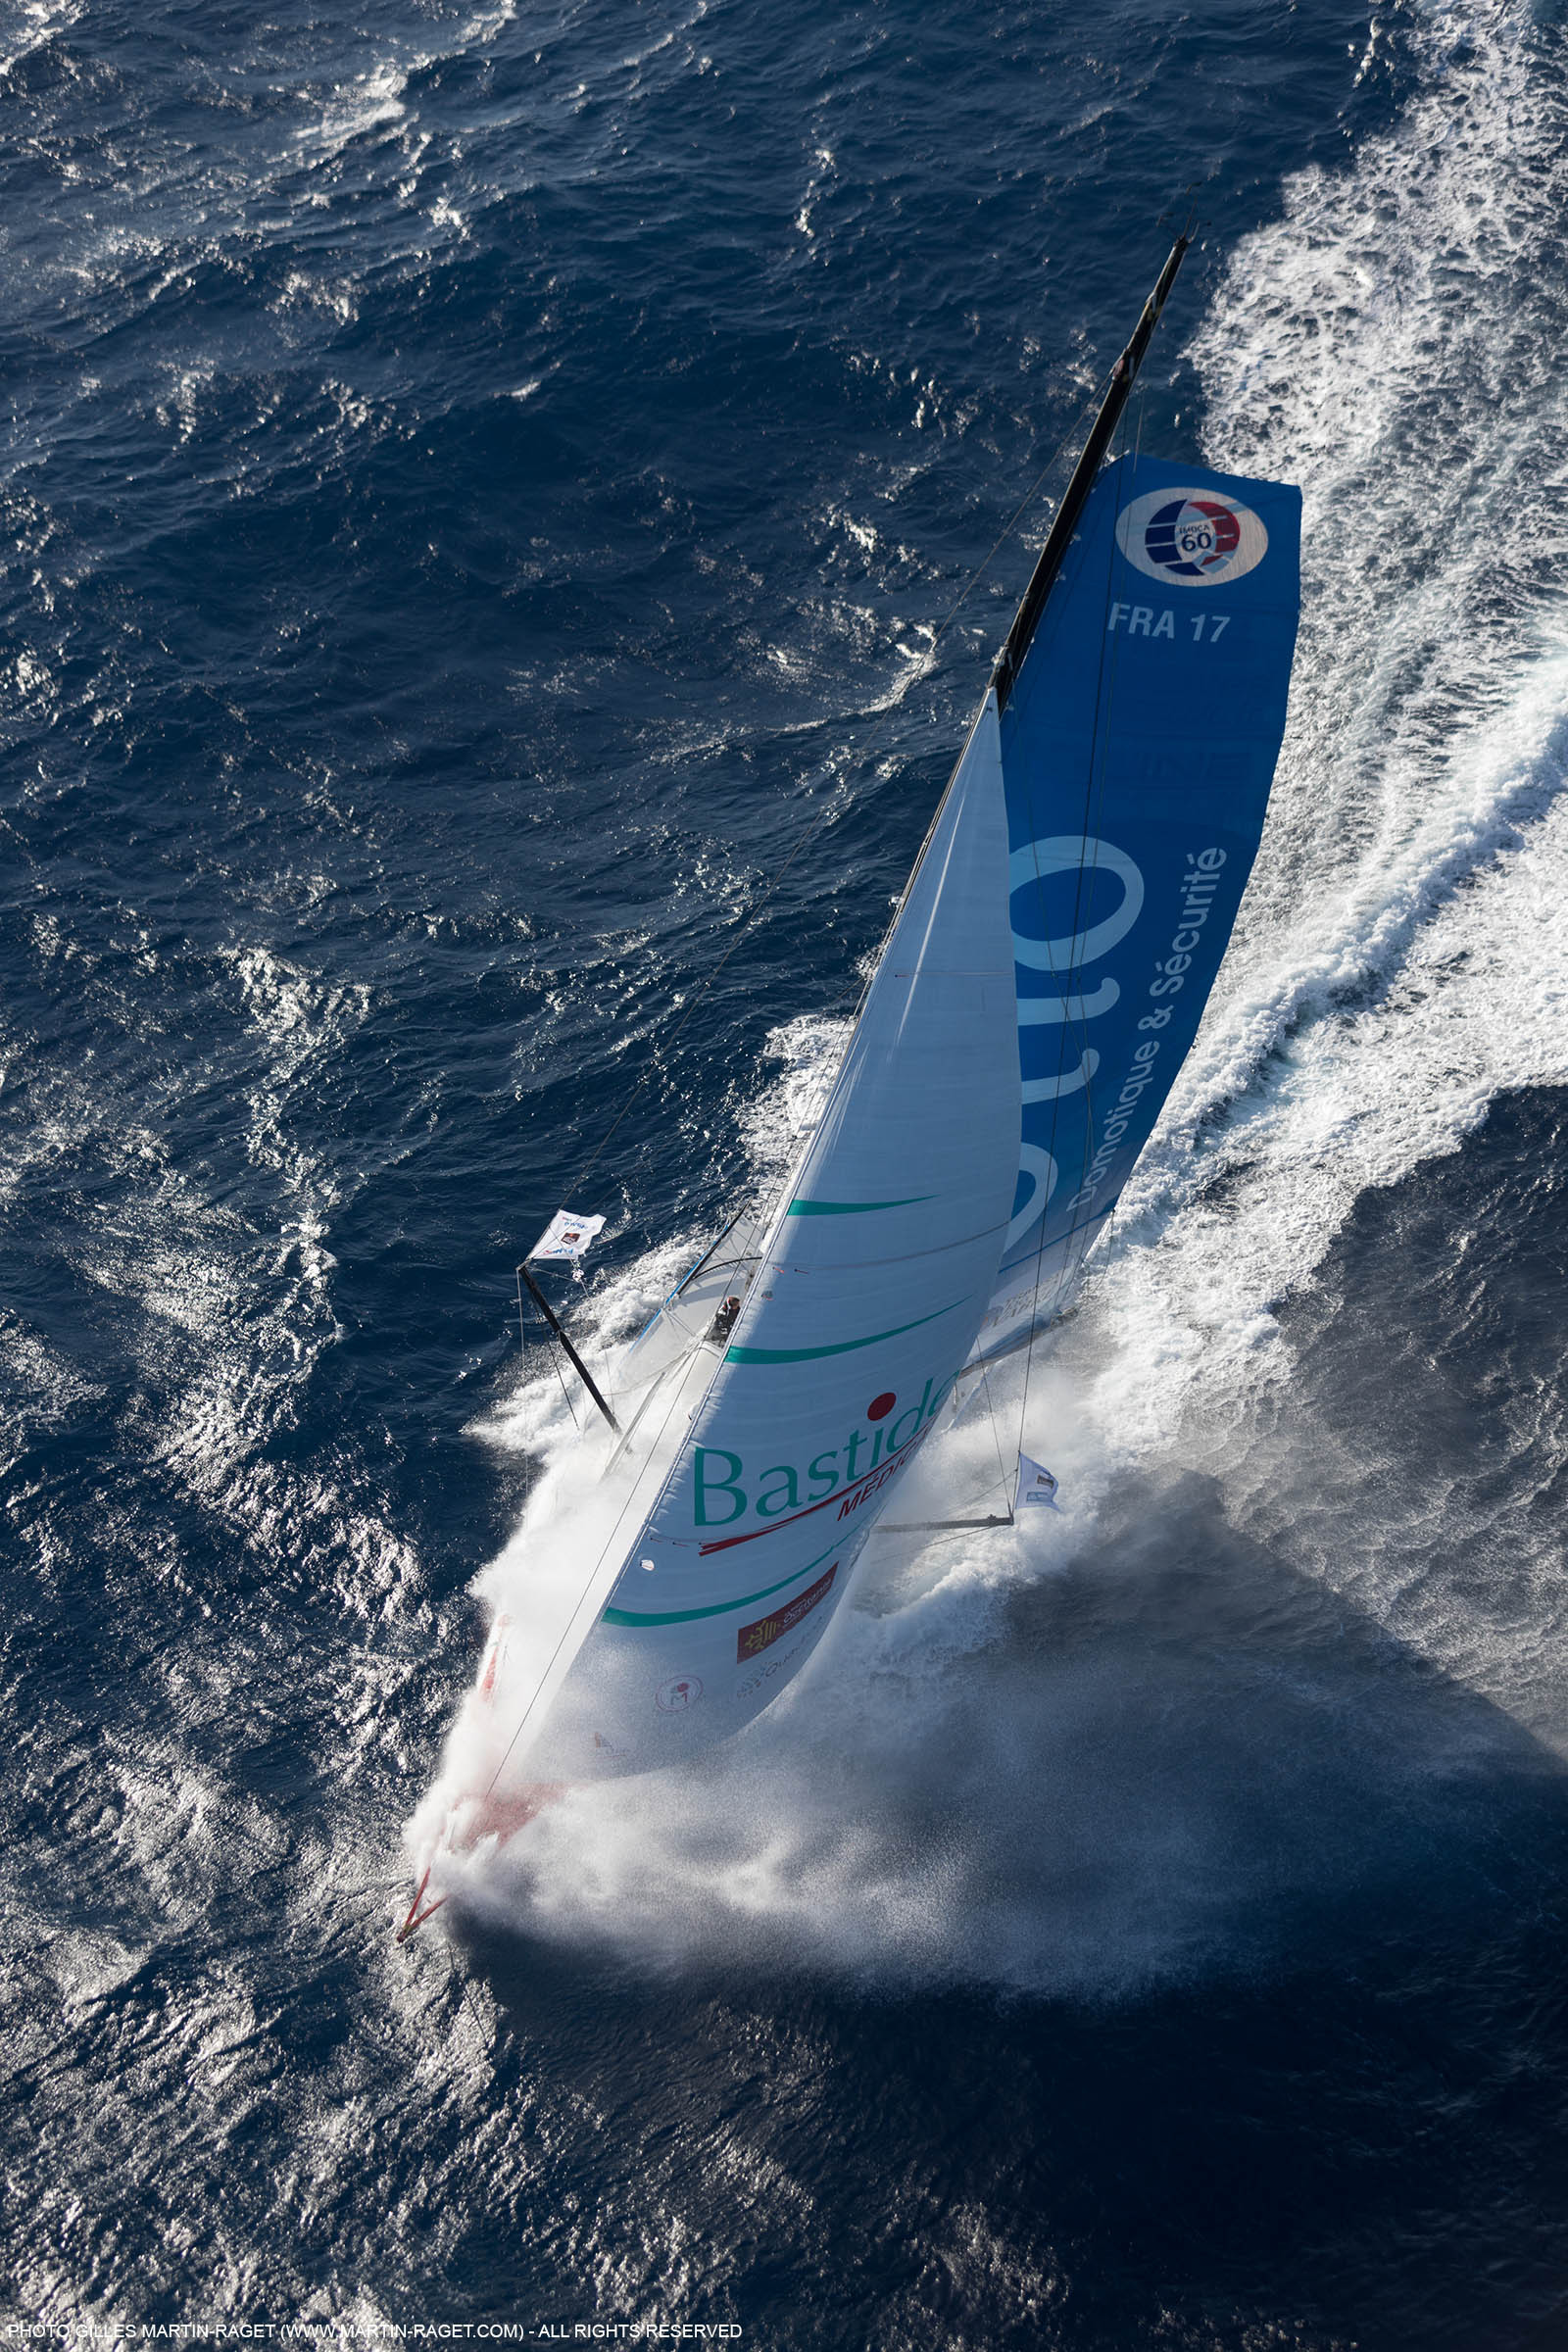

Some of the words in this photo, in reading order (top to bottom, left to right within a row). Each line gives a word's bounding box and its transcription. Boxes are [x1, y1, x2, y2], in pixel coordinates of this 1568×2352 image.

[1179, 524, 1210, 534] IMOCA
[1181, 532, 1212, 552] 60
[1107, 602, 1175, 639] FRA
[1191, 613, 1231, 643] 17
[1150, 848, 1227, 996] Sécurité
[1138, 1004, 1174, 1030] &
[1066, 1041, 1159, 1211] Domotique
